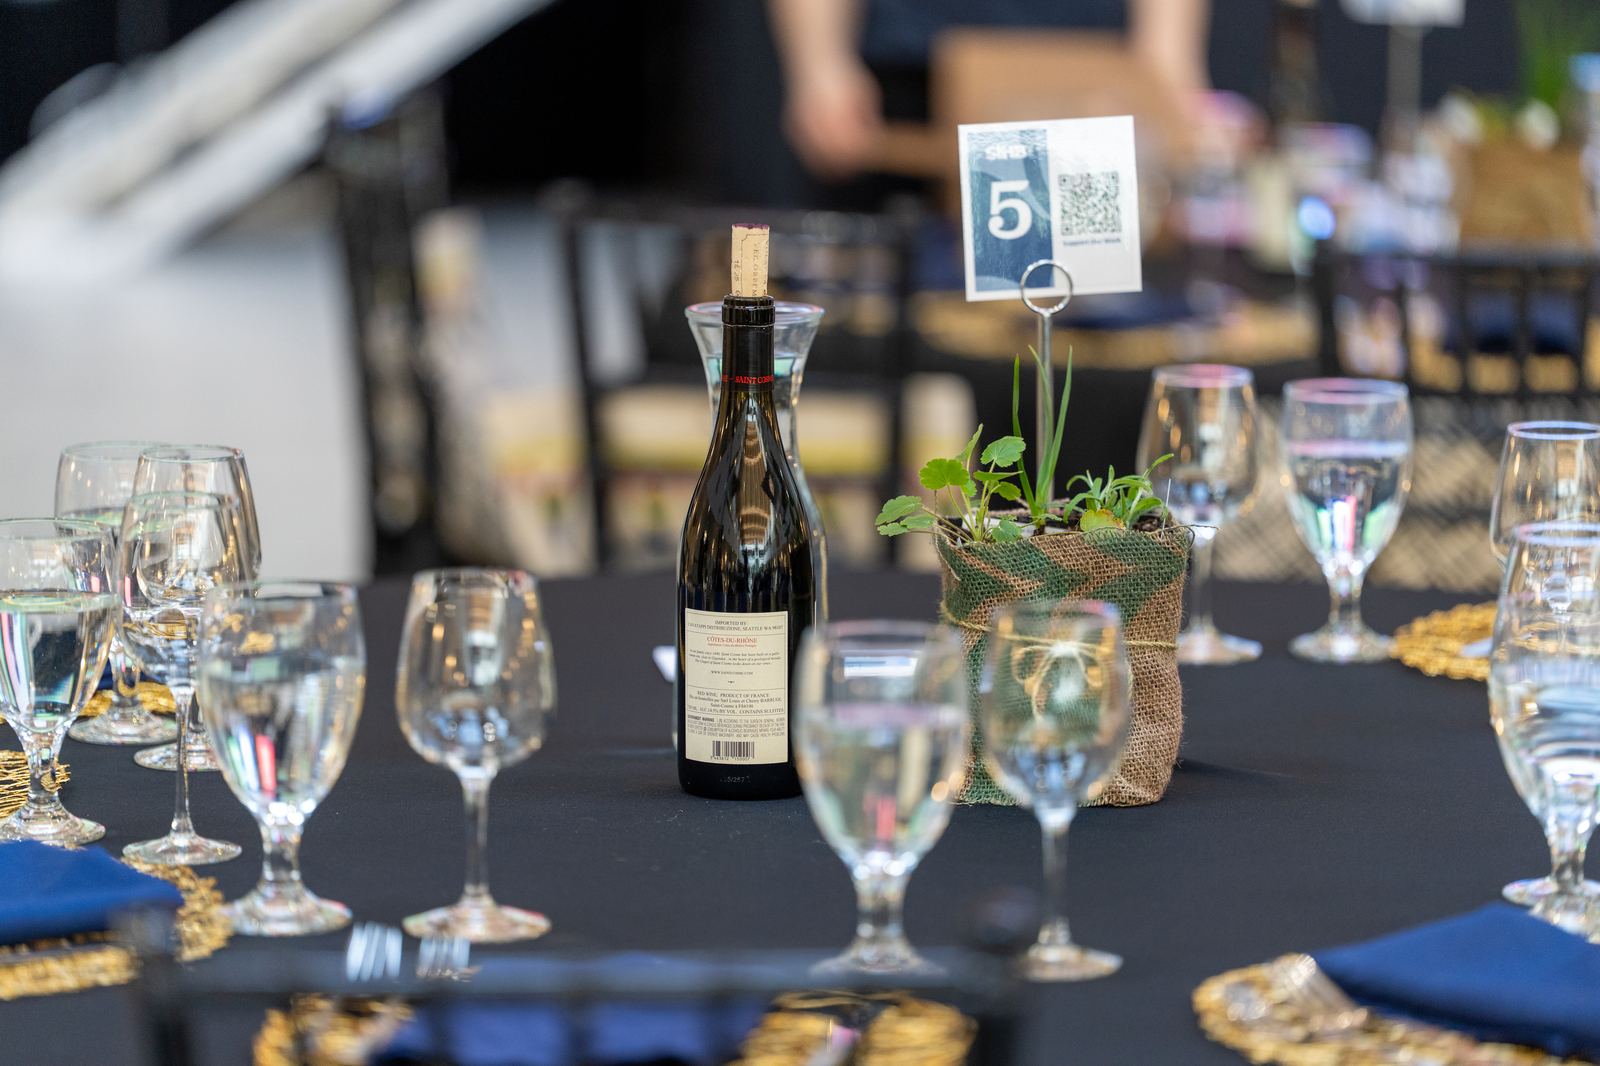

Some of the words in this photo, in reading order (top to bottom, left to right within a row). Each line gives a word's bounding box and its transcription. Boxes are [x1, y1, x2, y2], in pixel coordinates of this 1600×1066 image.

[988, 180, 1032, 240] 5
[736, 375, 757, 384] SAINT
[706, 636, 757, 644] CÔTES-DU-RHÔNE
